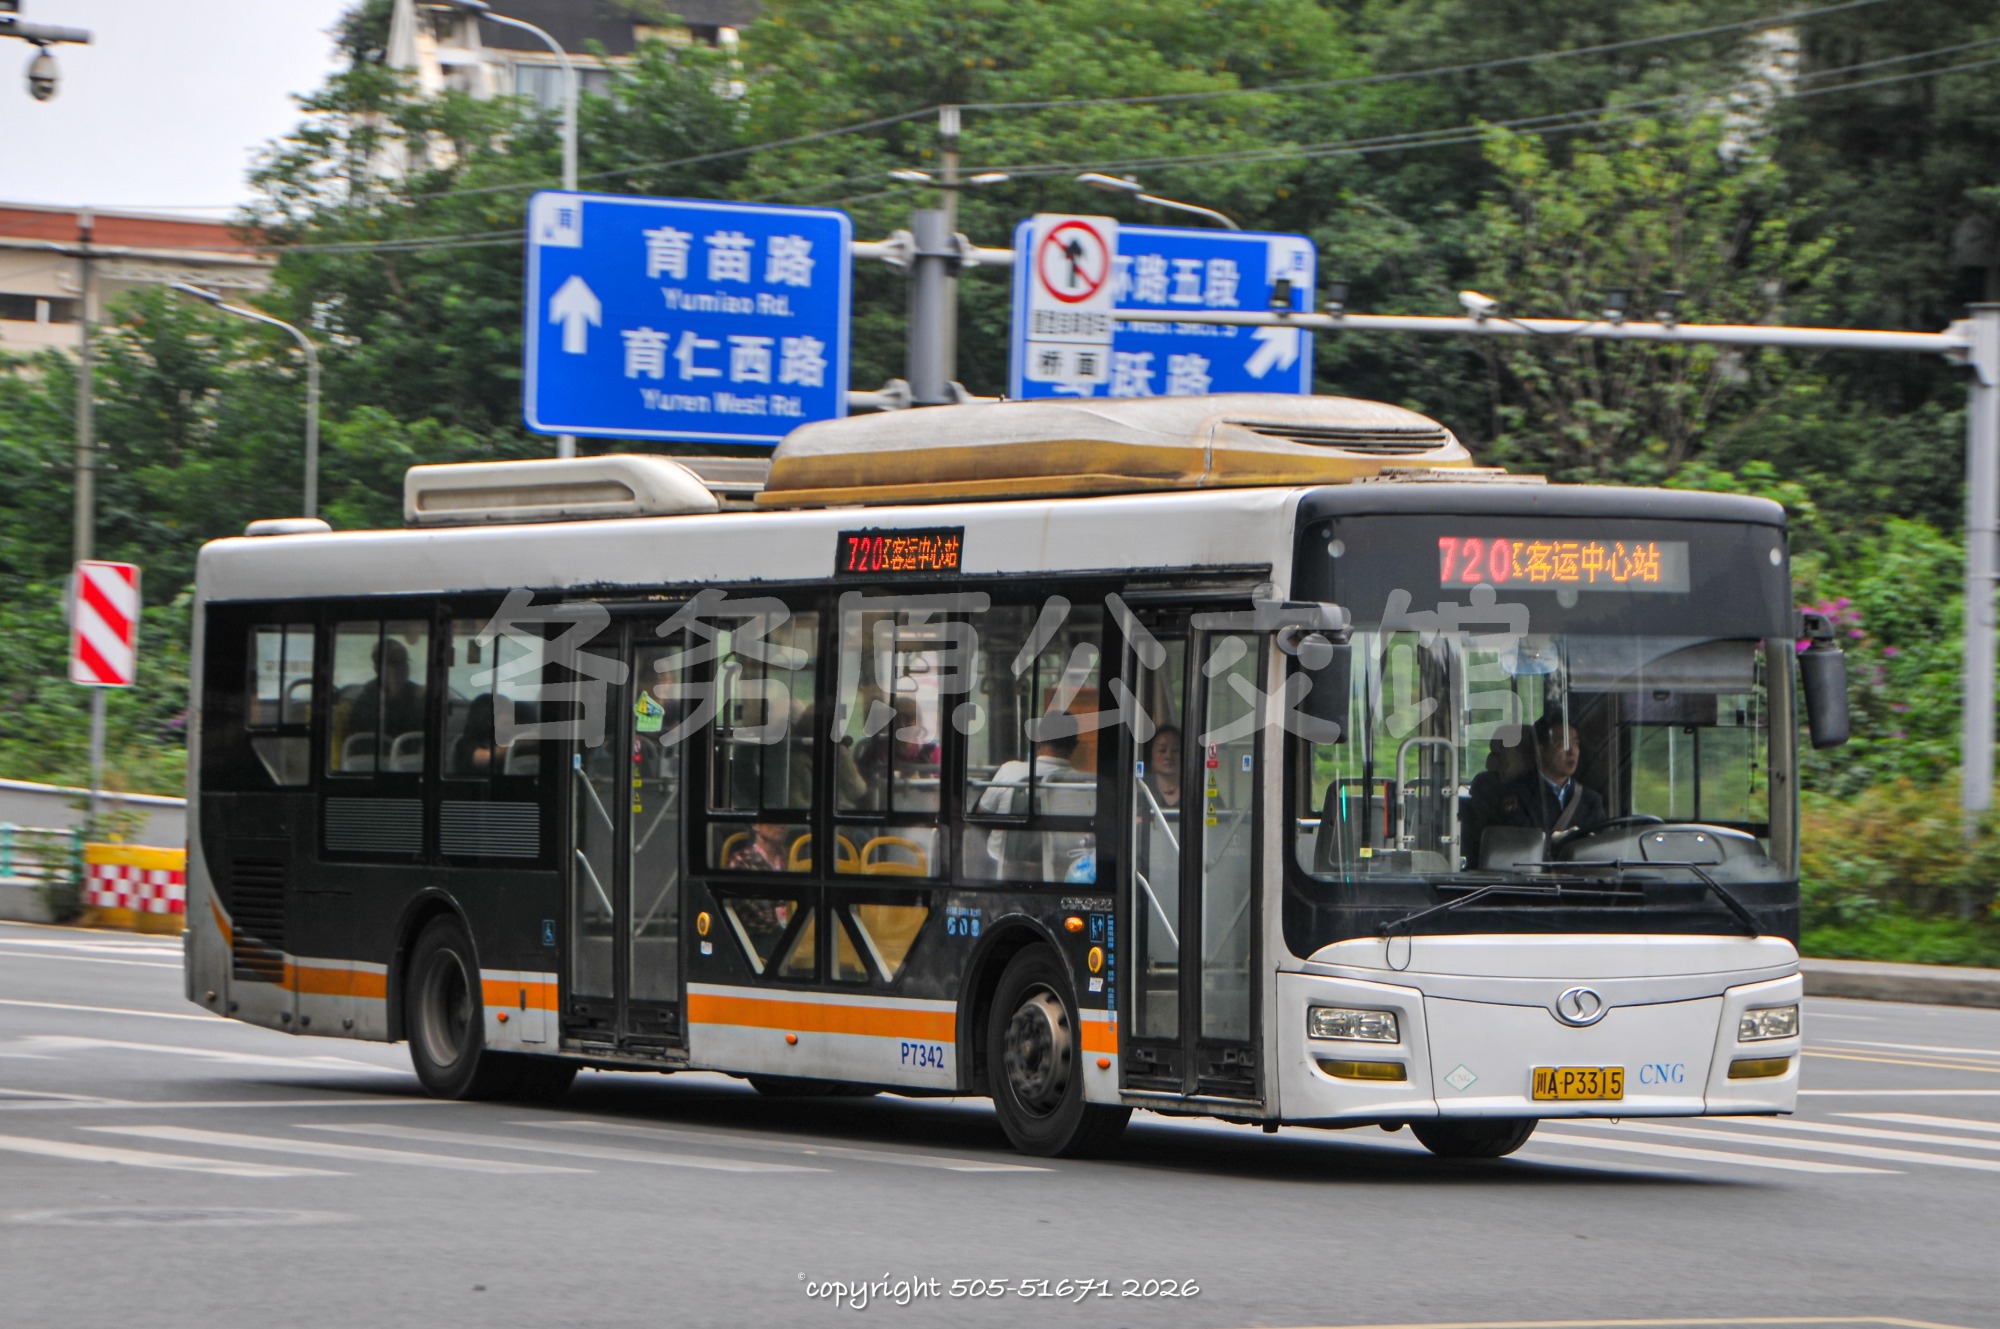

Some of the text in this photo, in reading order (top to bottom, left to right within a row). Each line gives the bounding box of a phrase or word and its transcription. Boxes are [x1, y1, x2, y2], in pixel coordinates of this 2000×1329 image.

[642, 226, 815, 287] 育苗路
[660, 287, 795, 317] Yumiao Rd.
[620, 327, 828, 388] 育仁西路
[1052, 351, 1213, 396] 跃路
[639, 388, 806, 418] Yuren West Rd.
[848, 536, 883, 572] 720
[1438, 536, 1511, 583] 720
[901, 1041, 945, 1069] P7342
[1639, 1063, 1685, 1085] CNG
